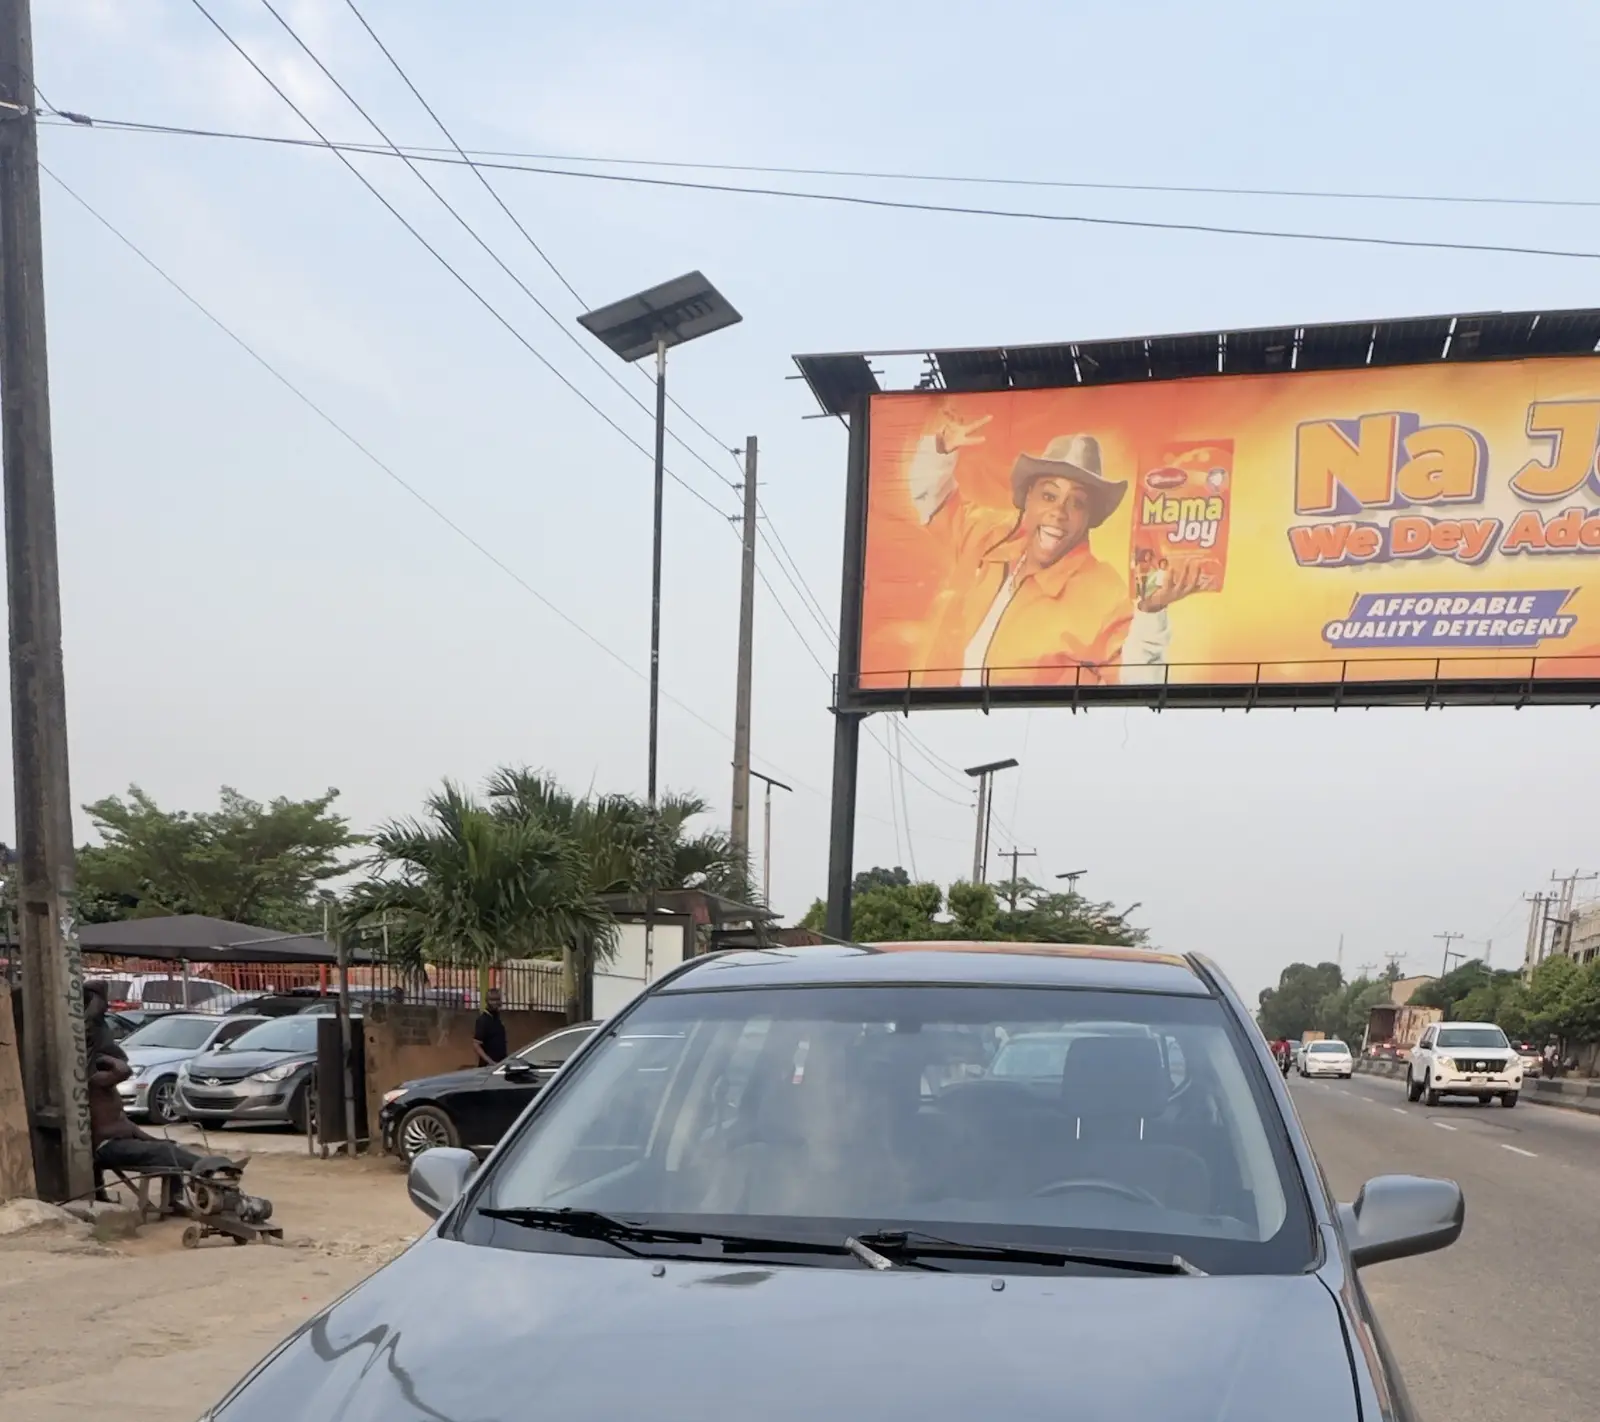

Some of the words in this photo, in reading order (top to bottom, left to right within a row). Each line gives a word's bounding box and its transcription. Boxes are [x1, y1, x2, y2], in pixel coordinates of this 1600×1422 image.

[1295, 411, 1489, 516] Na
[1508, 399, 1600, 504] J
[1141, 492, 1224, 526] Mama
[1167, 518, 1218, 549] Joy
[1287, 521, 1384, 567] We
[1389, 515, 1502, 563] Dey
[1366, 596, 1537, 617] AFFORDABLE
[1326, 619, 1427, 640] QUALITY
[1431, 617, 1573, 638] DETERGENT
